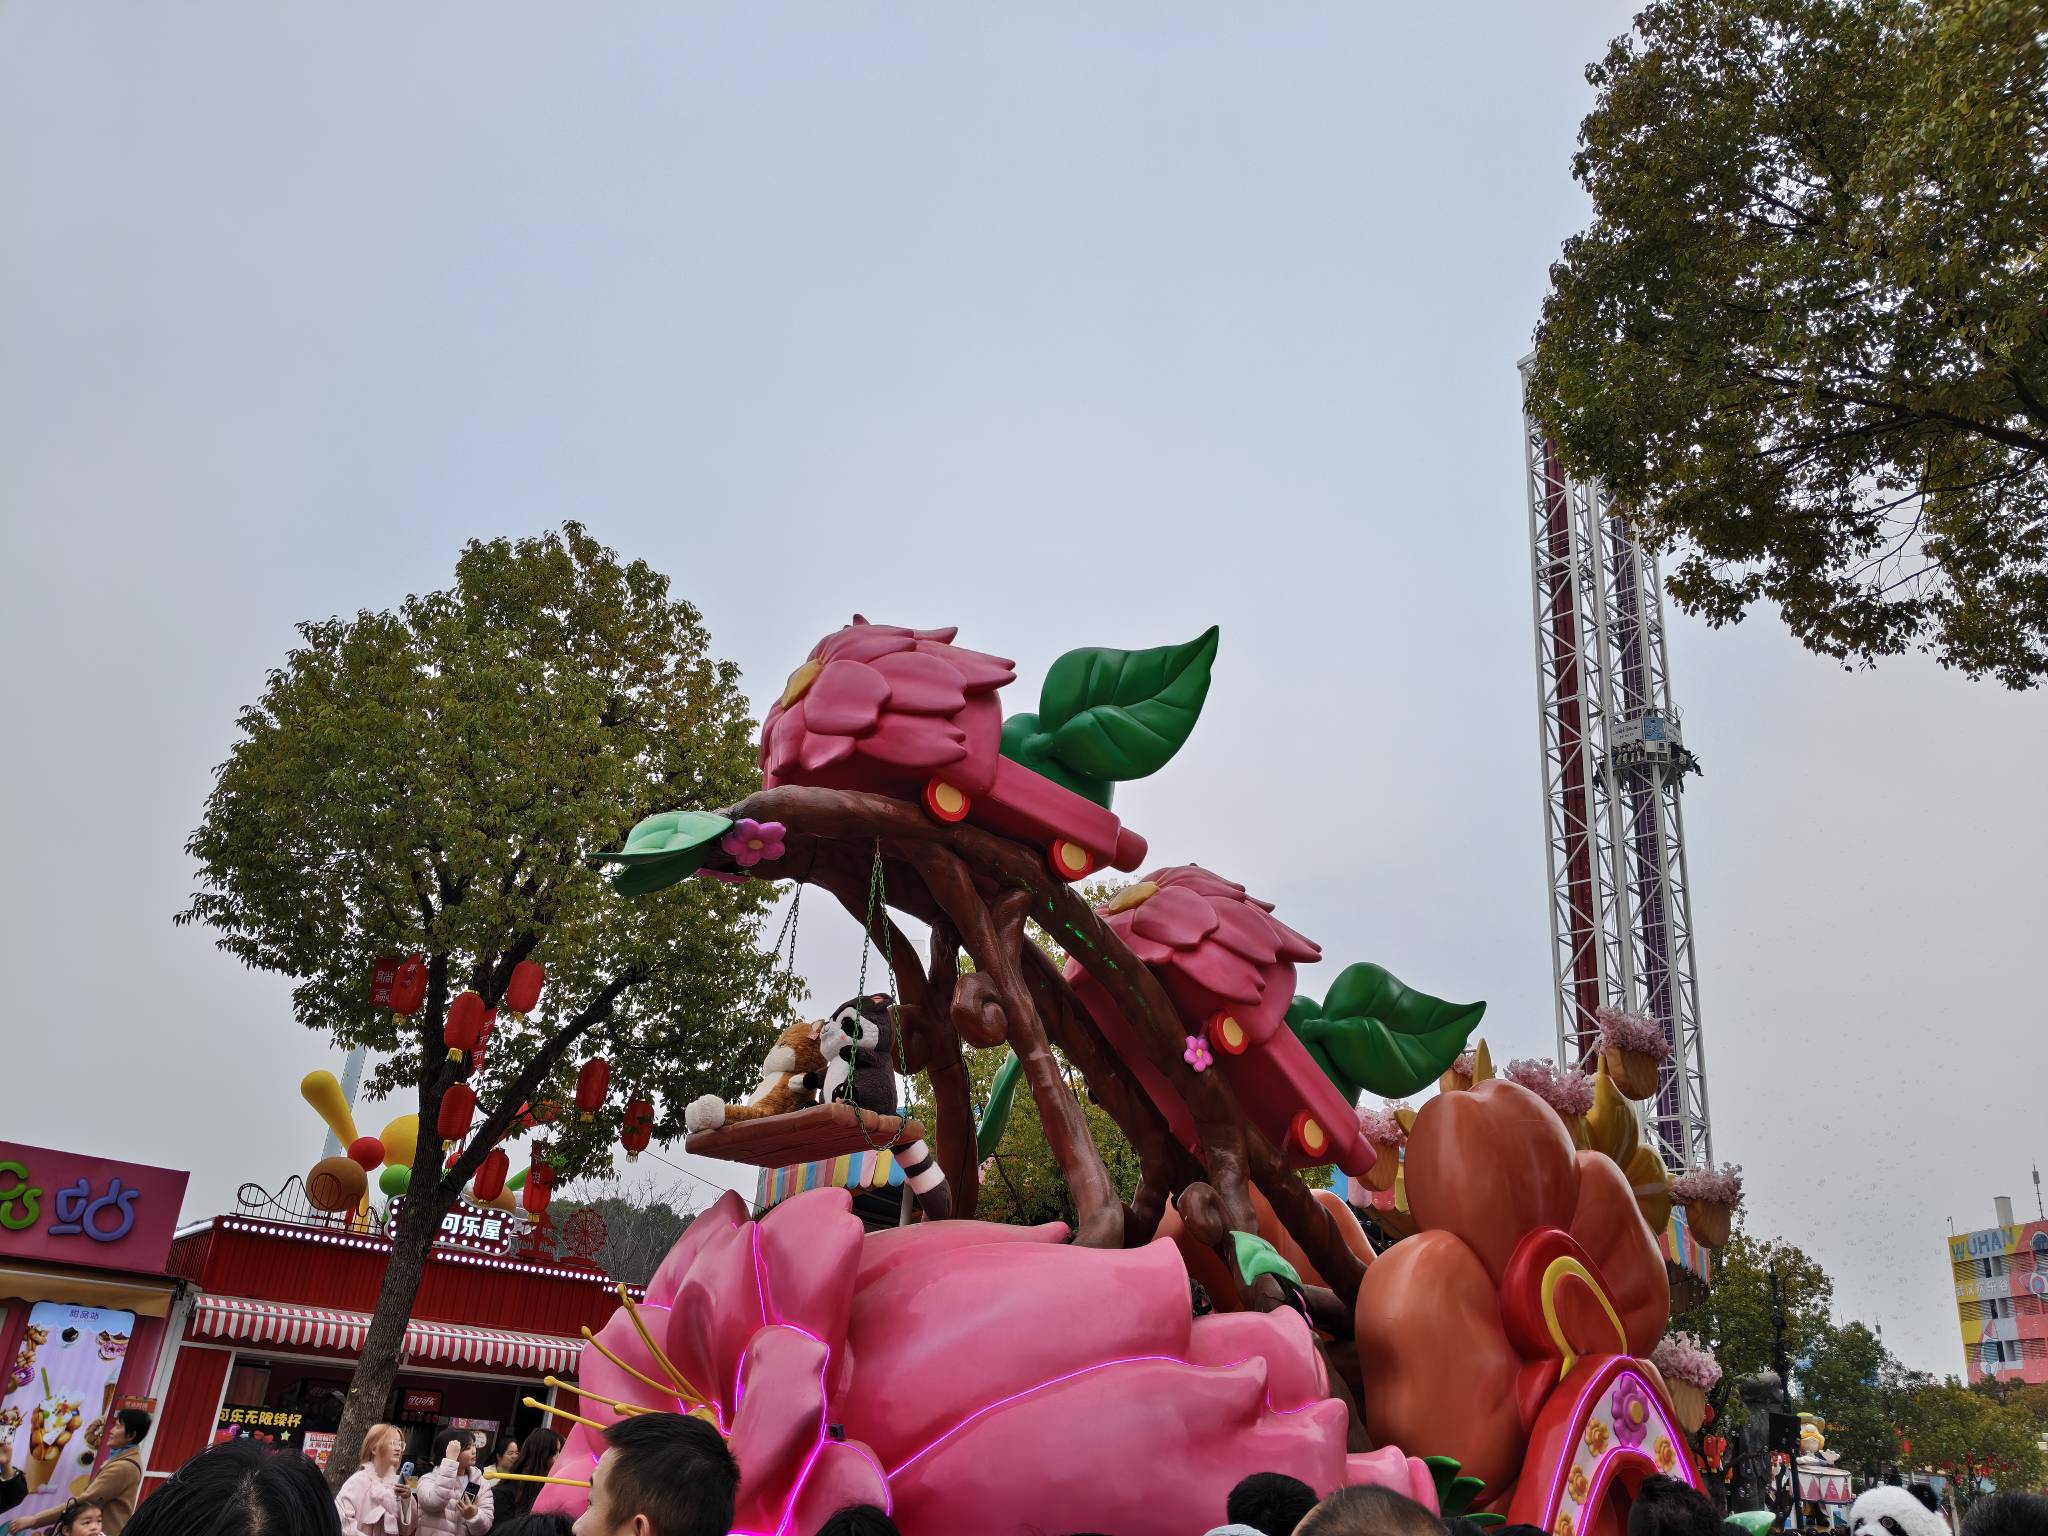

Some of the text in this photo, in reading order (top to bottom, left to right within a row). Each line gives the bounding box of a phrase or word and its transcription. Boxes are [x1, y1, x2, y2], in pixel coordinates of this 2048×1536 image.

[440, 1212, 502, 1241] 可乐屋
[1951, 1226, 2015, 1260] WUHAN
[70, 1309, 99, 1320] 甜品站
[407, 1396, 436, 1407] 可口可乐
[219, 1408, 303, 1428] 可乐无限续杯
